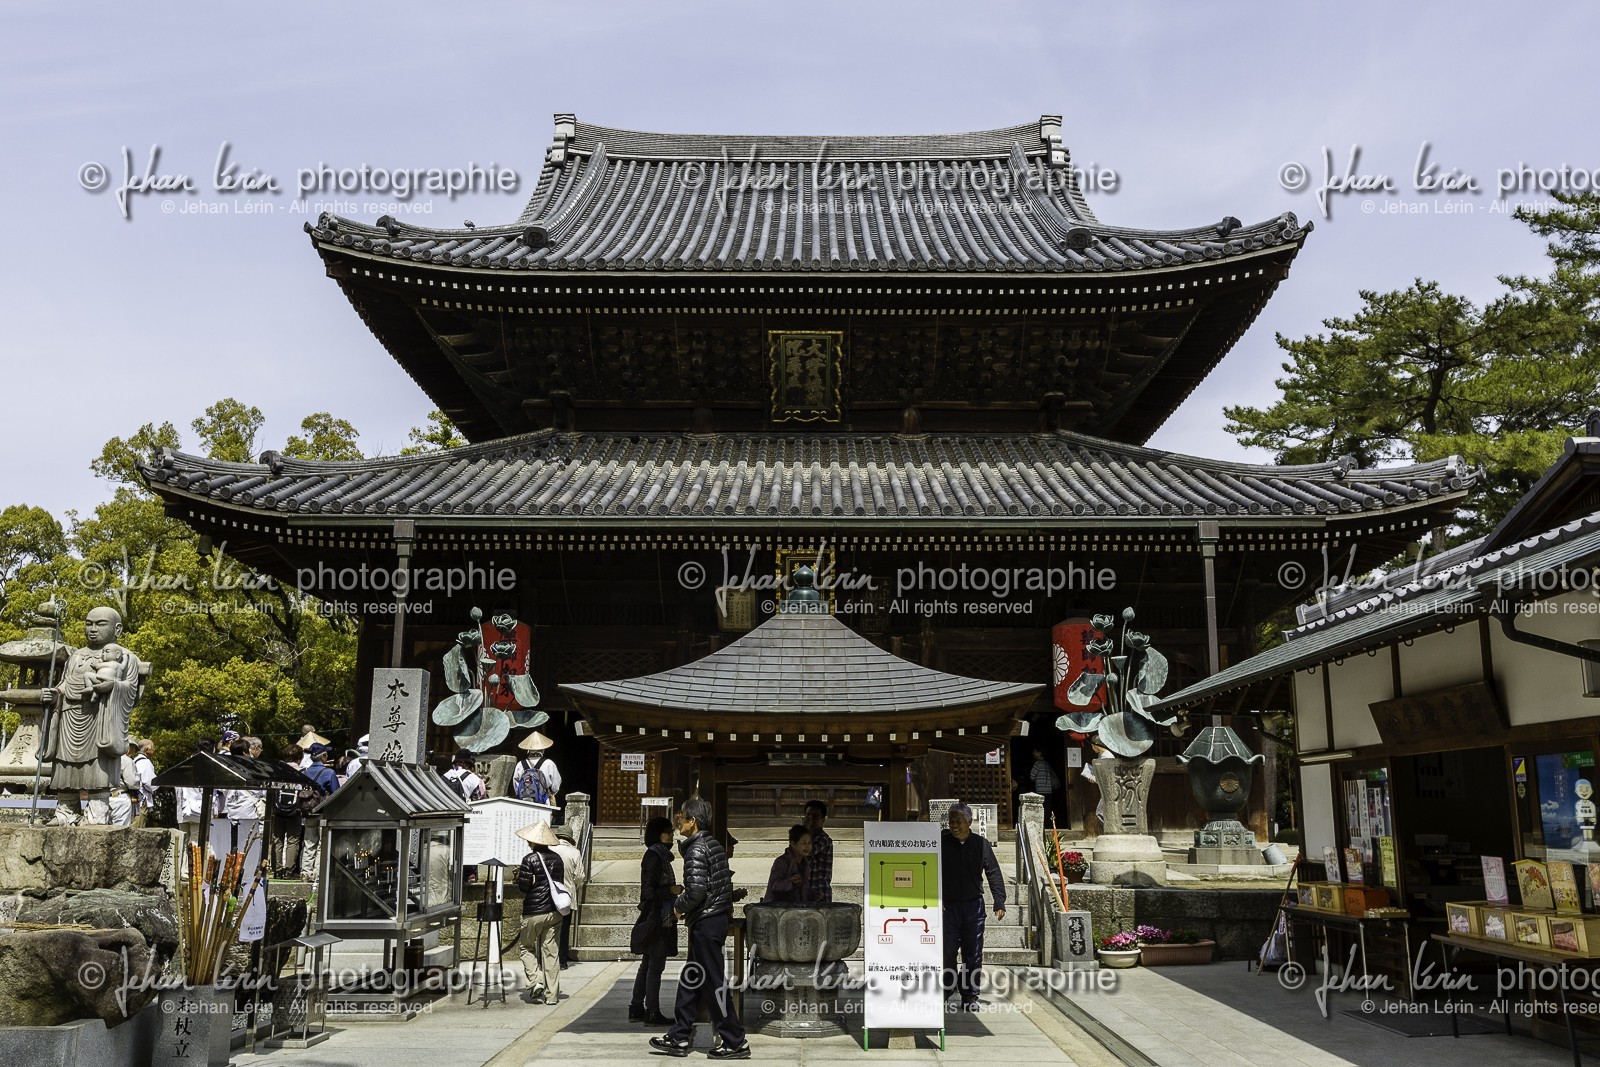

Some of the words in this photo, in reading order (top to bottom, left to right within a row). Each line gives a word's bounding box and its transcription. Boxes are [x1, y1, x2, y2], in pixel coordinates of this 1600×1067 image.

[868, 839, 938, 848] 堂内順路変更のお知らせ
